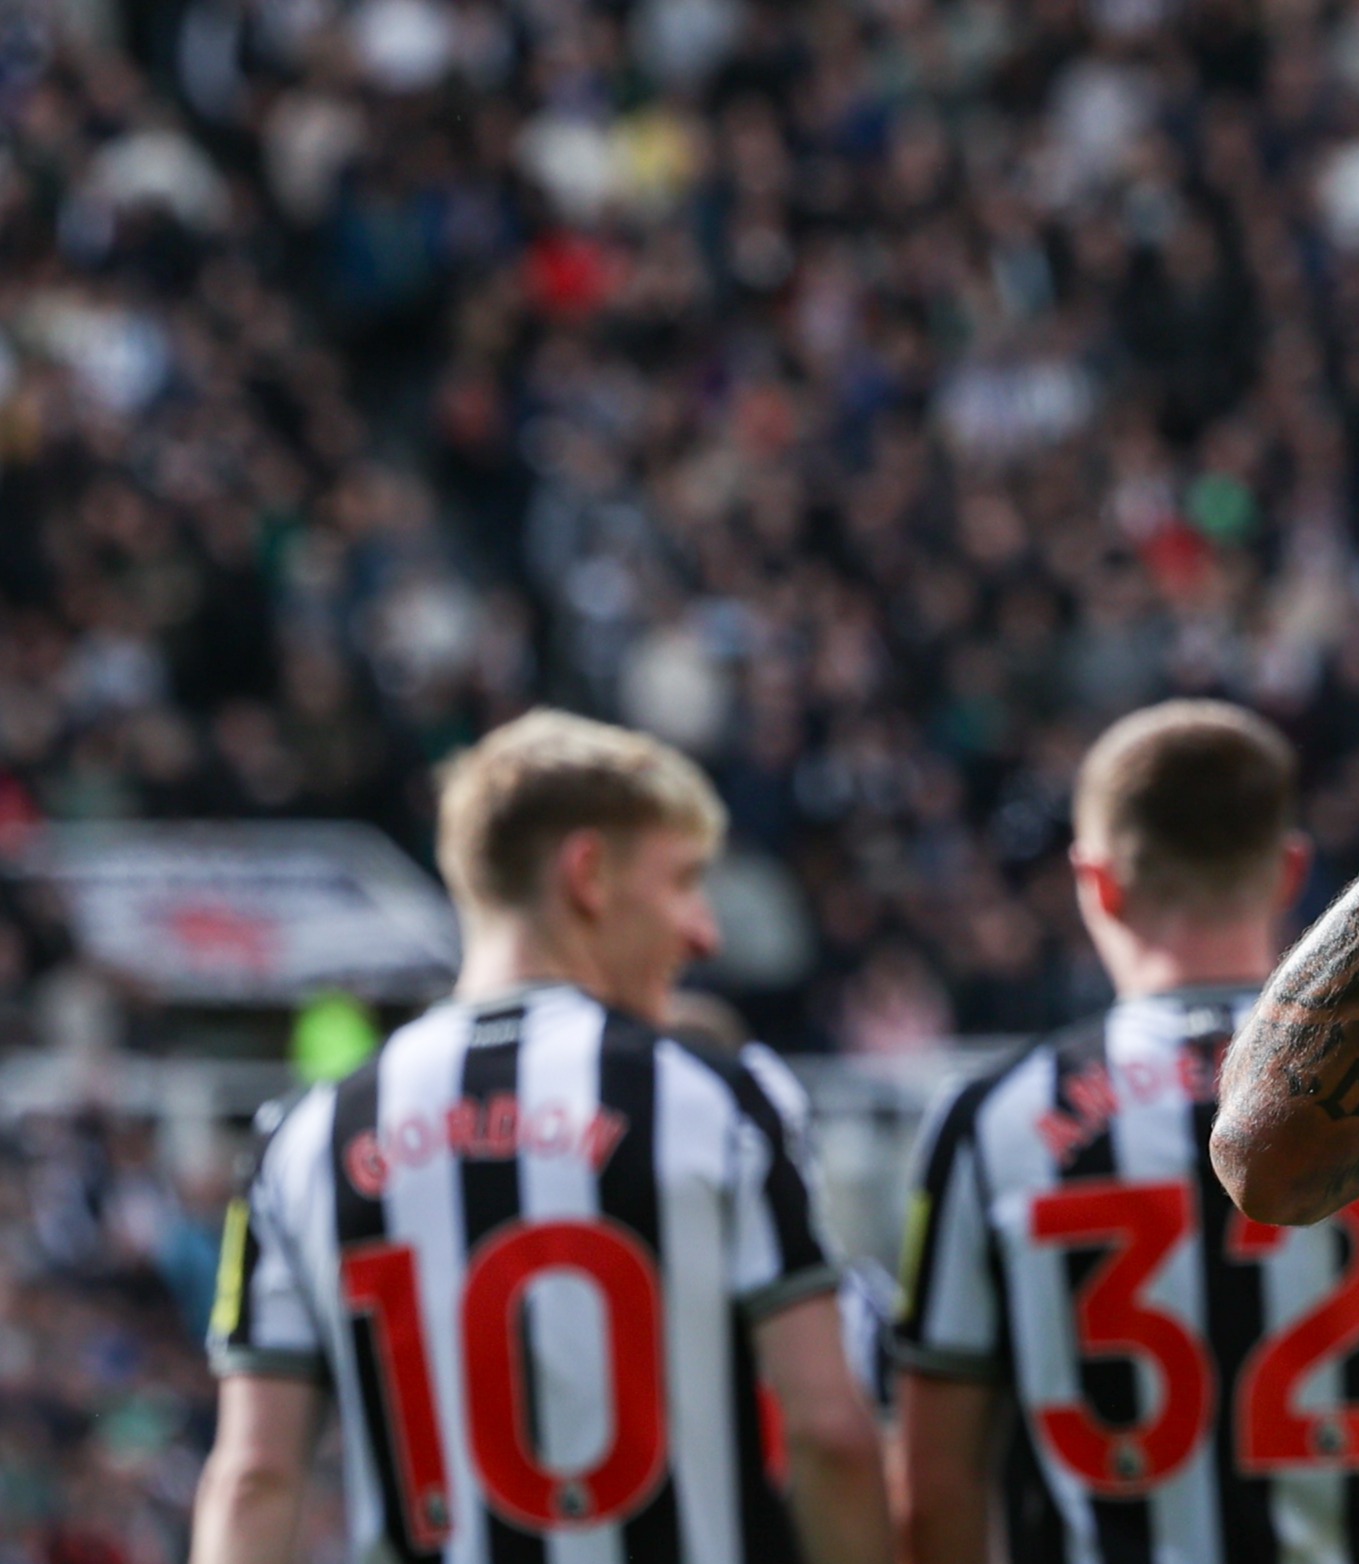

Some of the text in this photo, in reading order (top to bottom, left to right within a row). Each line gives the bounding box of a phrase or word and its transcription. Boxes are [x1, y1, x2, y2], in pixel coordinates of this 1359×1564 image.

[345, 1094, 629, 1197] GORDON
[1035, 1042, 1231, 1167] ANDE
[342, 1217, 667, 1551] 10
